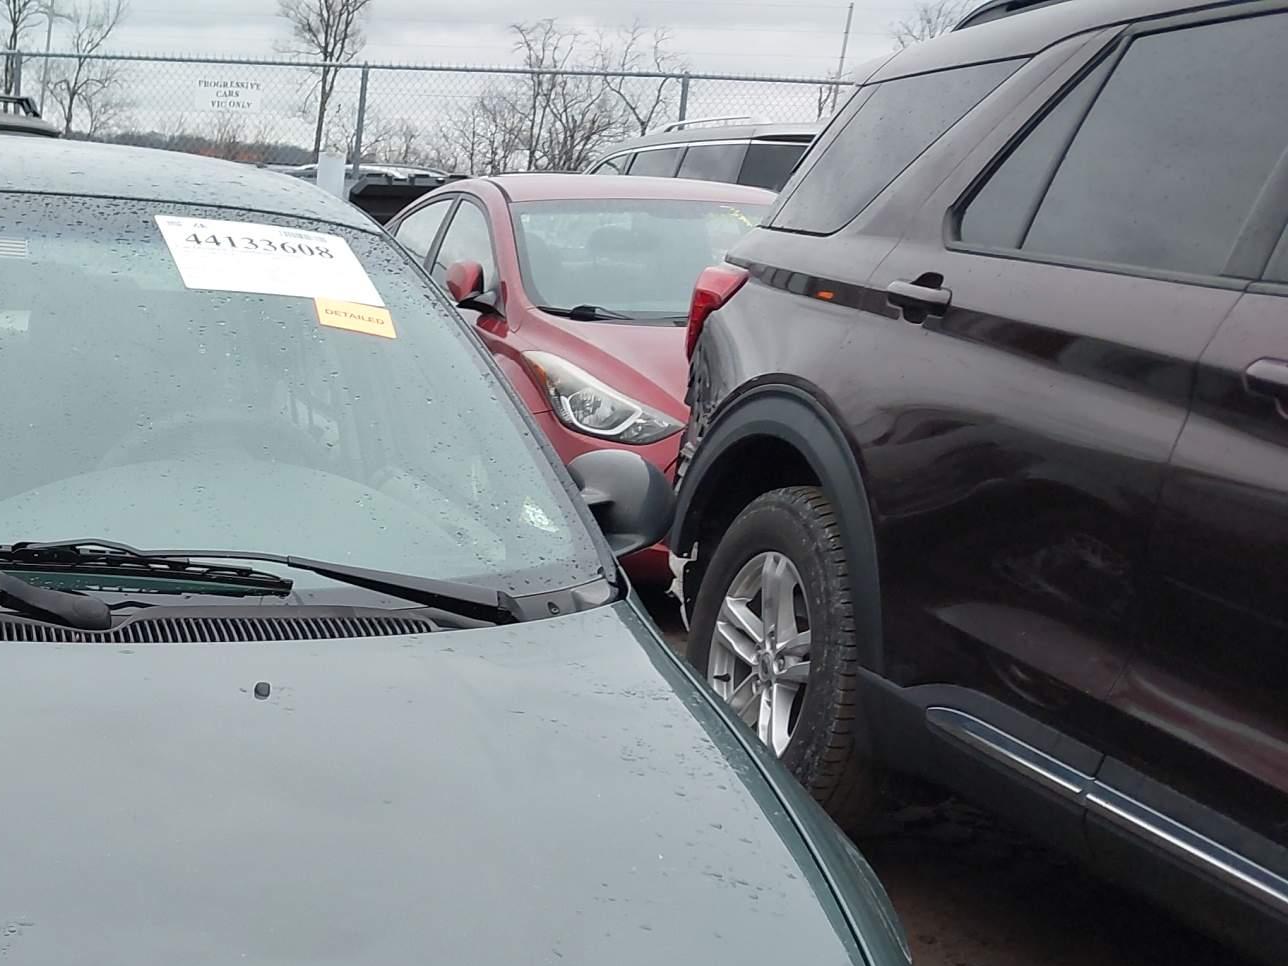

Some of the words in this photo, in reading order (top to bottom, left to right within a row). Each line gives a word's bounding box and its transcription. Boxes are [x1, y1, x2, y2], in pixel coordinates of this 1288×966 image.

[198, 79, 261, 90] PROGRESSIVE
[215, 90, 240, 98] CARS
[228, 100, 252, 109] ONLY
[185, 232, 334, 260] 44133608
[324, 308, 385, 326] DETAILED
